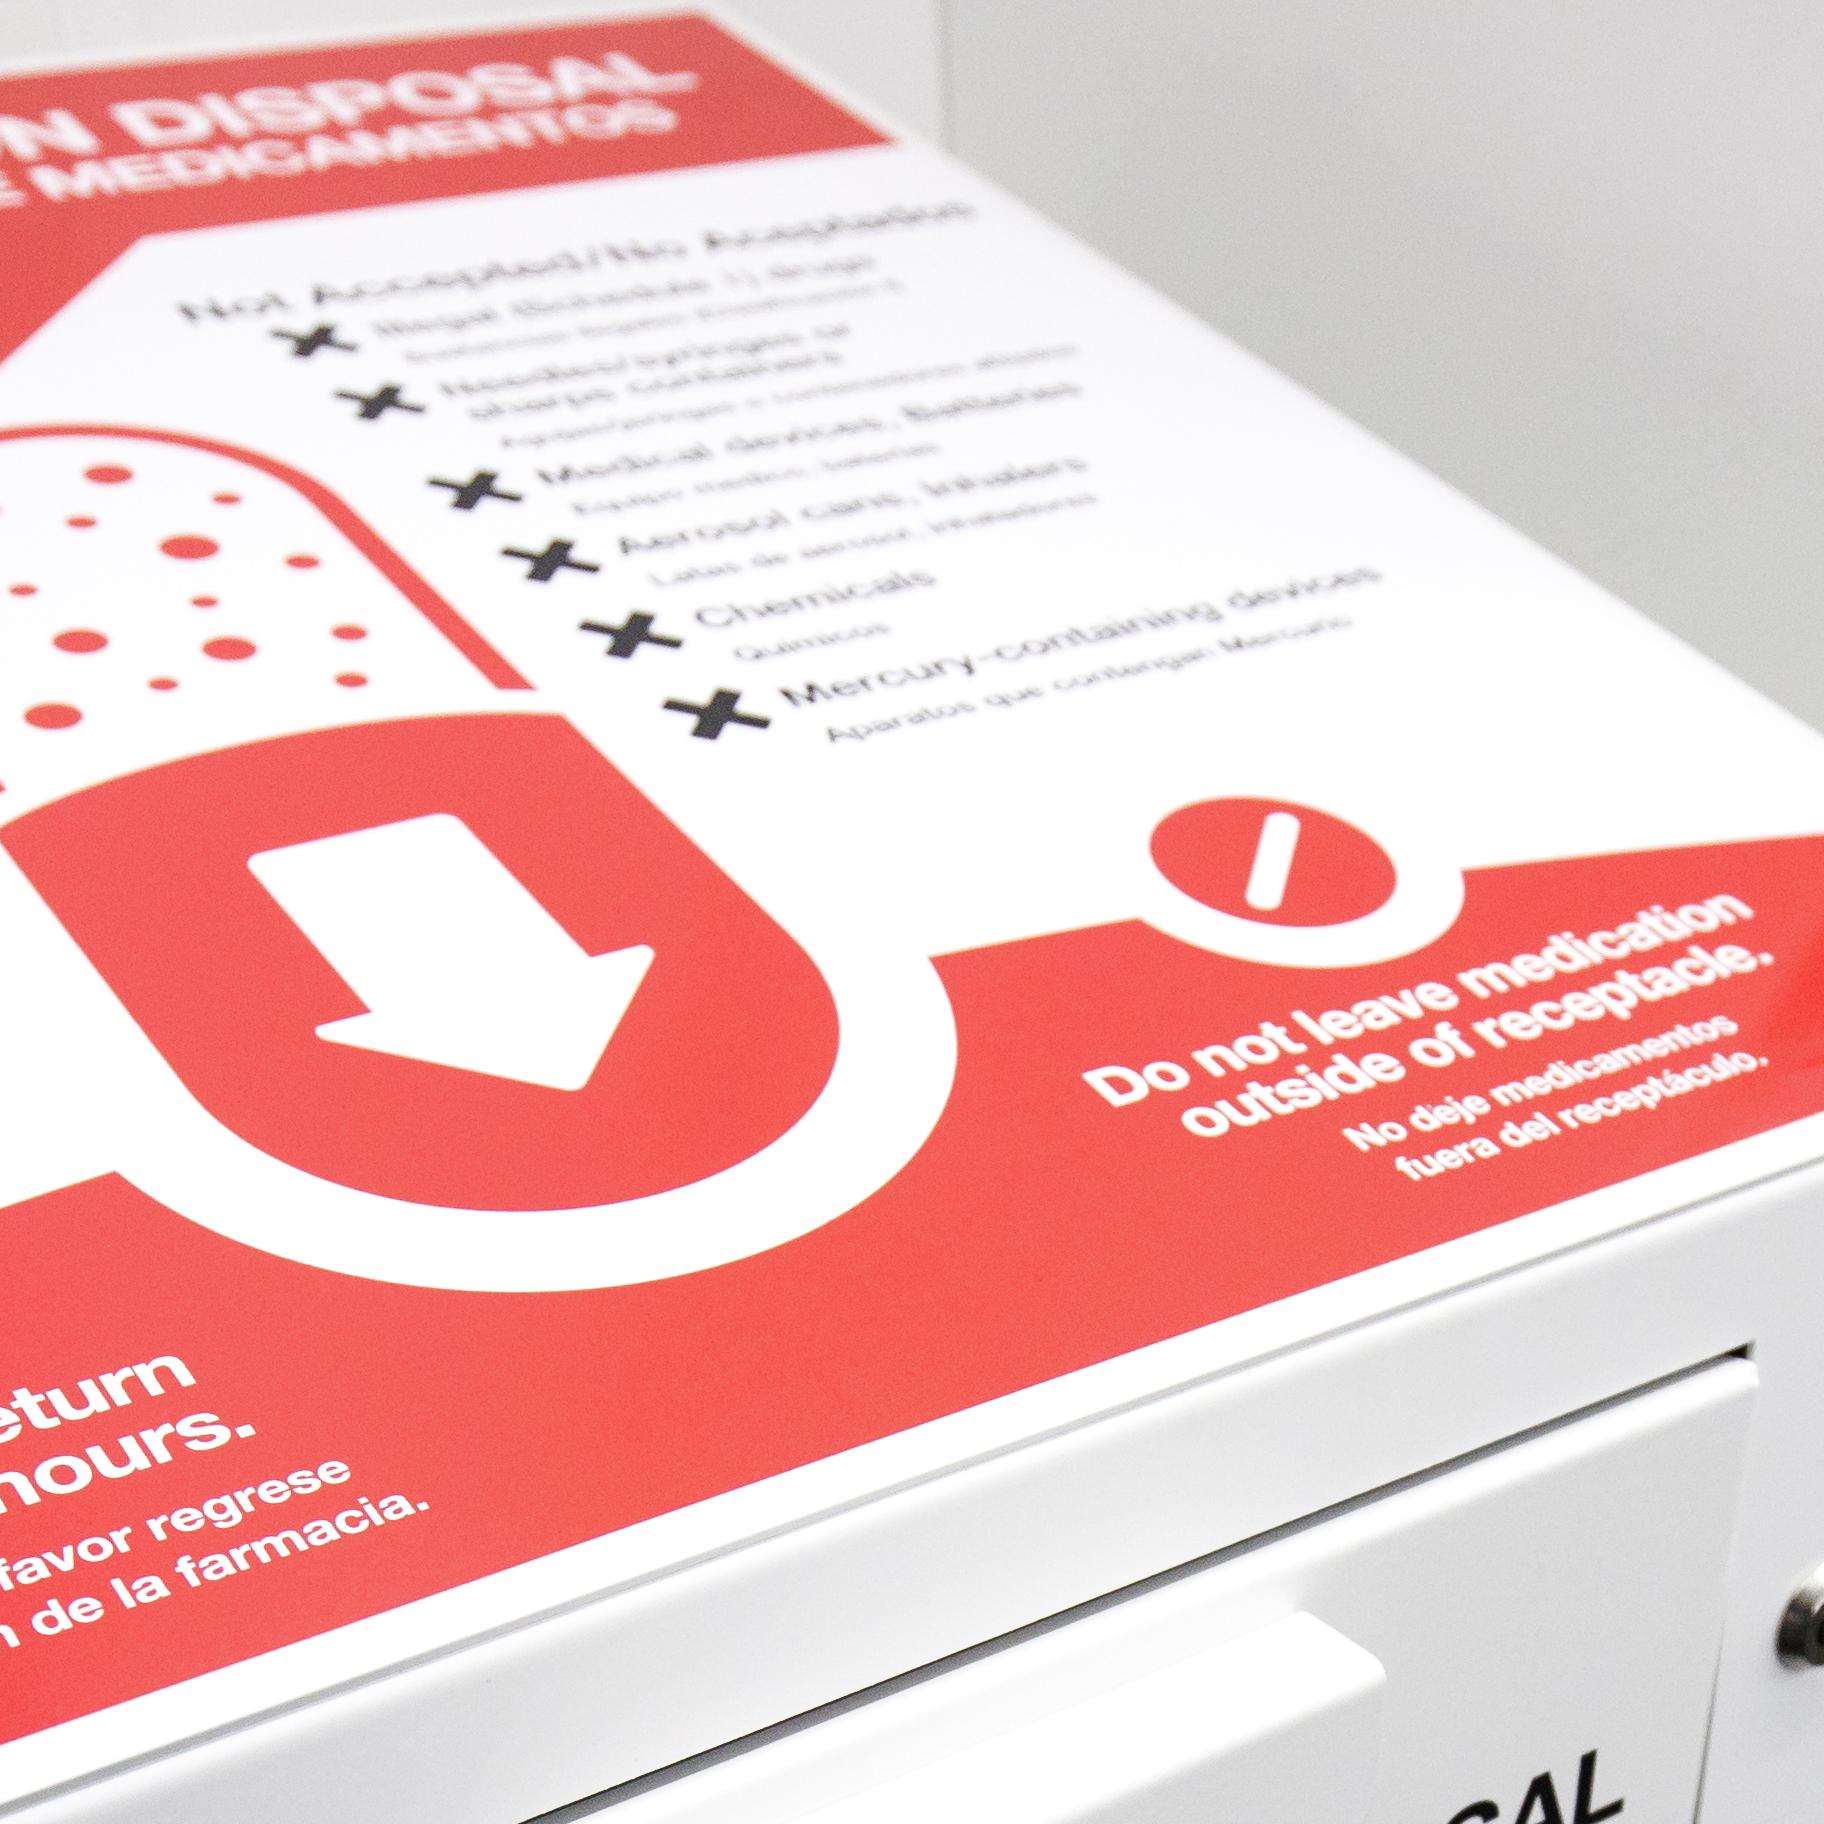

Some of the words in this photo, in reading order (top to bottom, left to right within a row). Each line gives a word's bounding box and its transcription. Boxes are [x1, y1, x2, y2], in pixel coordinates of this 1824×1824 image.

[111, 53, 695, 147] DISPOSAL
[30, 99, 676, 200] MEDICAMENTOS
[177, 293, 289, 324] Not
[535, 444, 713, 486] Medical
[618, 510, 789, 557] Aerosol
[693, 572, 937, 628] Chemicals
[778, 604, 1223, 708] Mercury-containing
[1227, 568, 1382, 610] devices
[826, 702, 977, 744] Aparatos
[984, 687, 1044, 708] que
[1082, 1062, 1190, 1107] Do
[1192, 1022, 1307, 1077] not
[1291, 982, 1459, 1045] leave
[1457, 895, 1753, 998] medication
[1181, 1053, 1406, 1137] outside
[1409, 1022, 1475, 1067] of
[1472, 945, 1774, 1048] receptacle.
[1342, 1122, 1407, 1152] No
[1409, 1095, 1491, 1132] deje
[1490, 1016, 1738, 1106] medicamentos
[1395, 1137, 1501, 1181] fuera
[1499, 1112, 1561, 1147] del
[1557, 1052, 1768, 1129] receptáculo.
[147, 1461, 351, 1541] regrese
[32, 1597, 104, 1635] de
[111, 1576, 171, 1608] la
[175, 1495, 429, 1587] farmacia.
